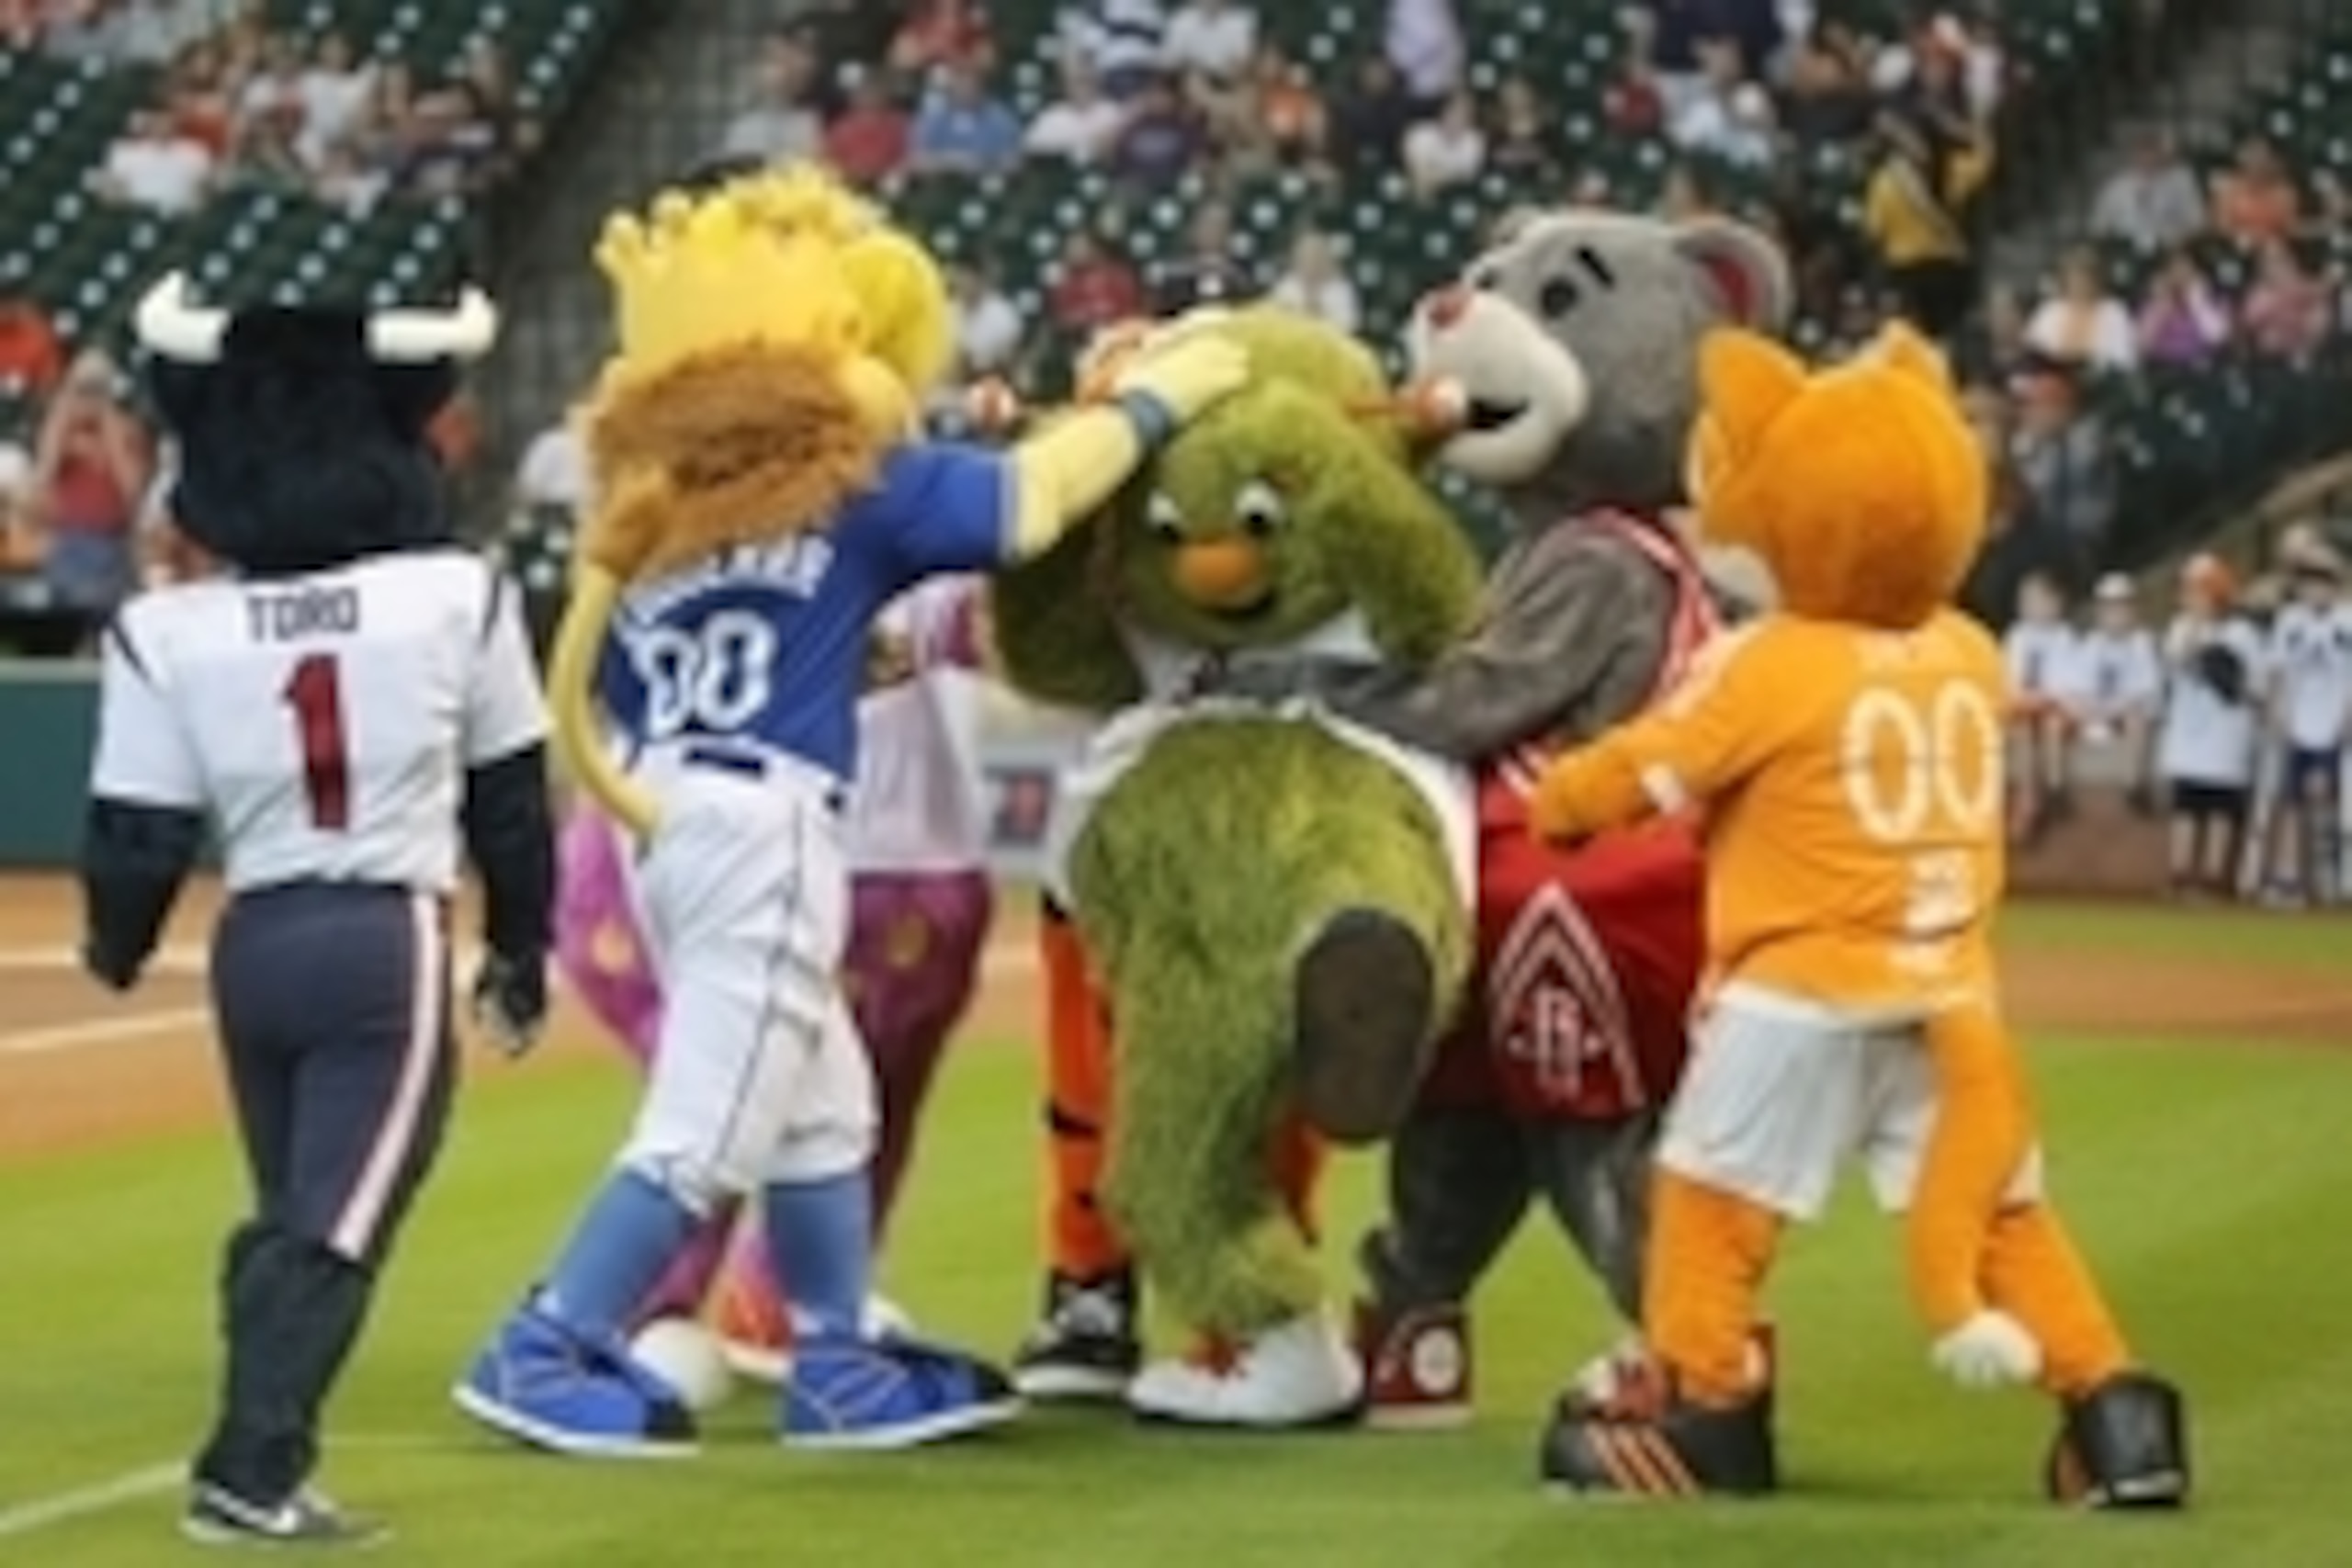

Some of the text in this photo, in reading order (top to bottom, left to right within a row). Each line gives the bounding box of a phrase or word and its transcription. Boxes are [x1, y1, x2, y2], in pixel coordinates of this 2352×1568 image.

[246, 586, 359, 642] TORO
[623, 611, 778, 738] 00
[284, 652, 350, 832] 1
[1842, 678, 2004, 843] 00
